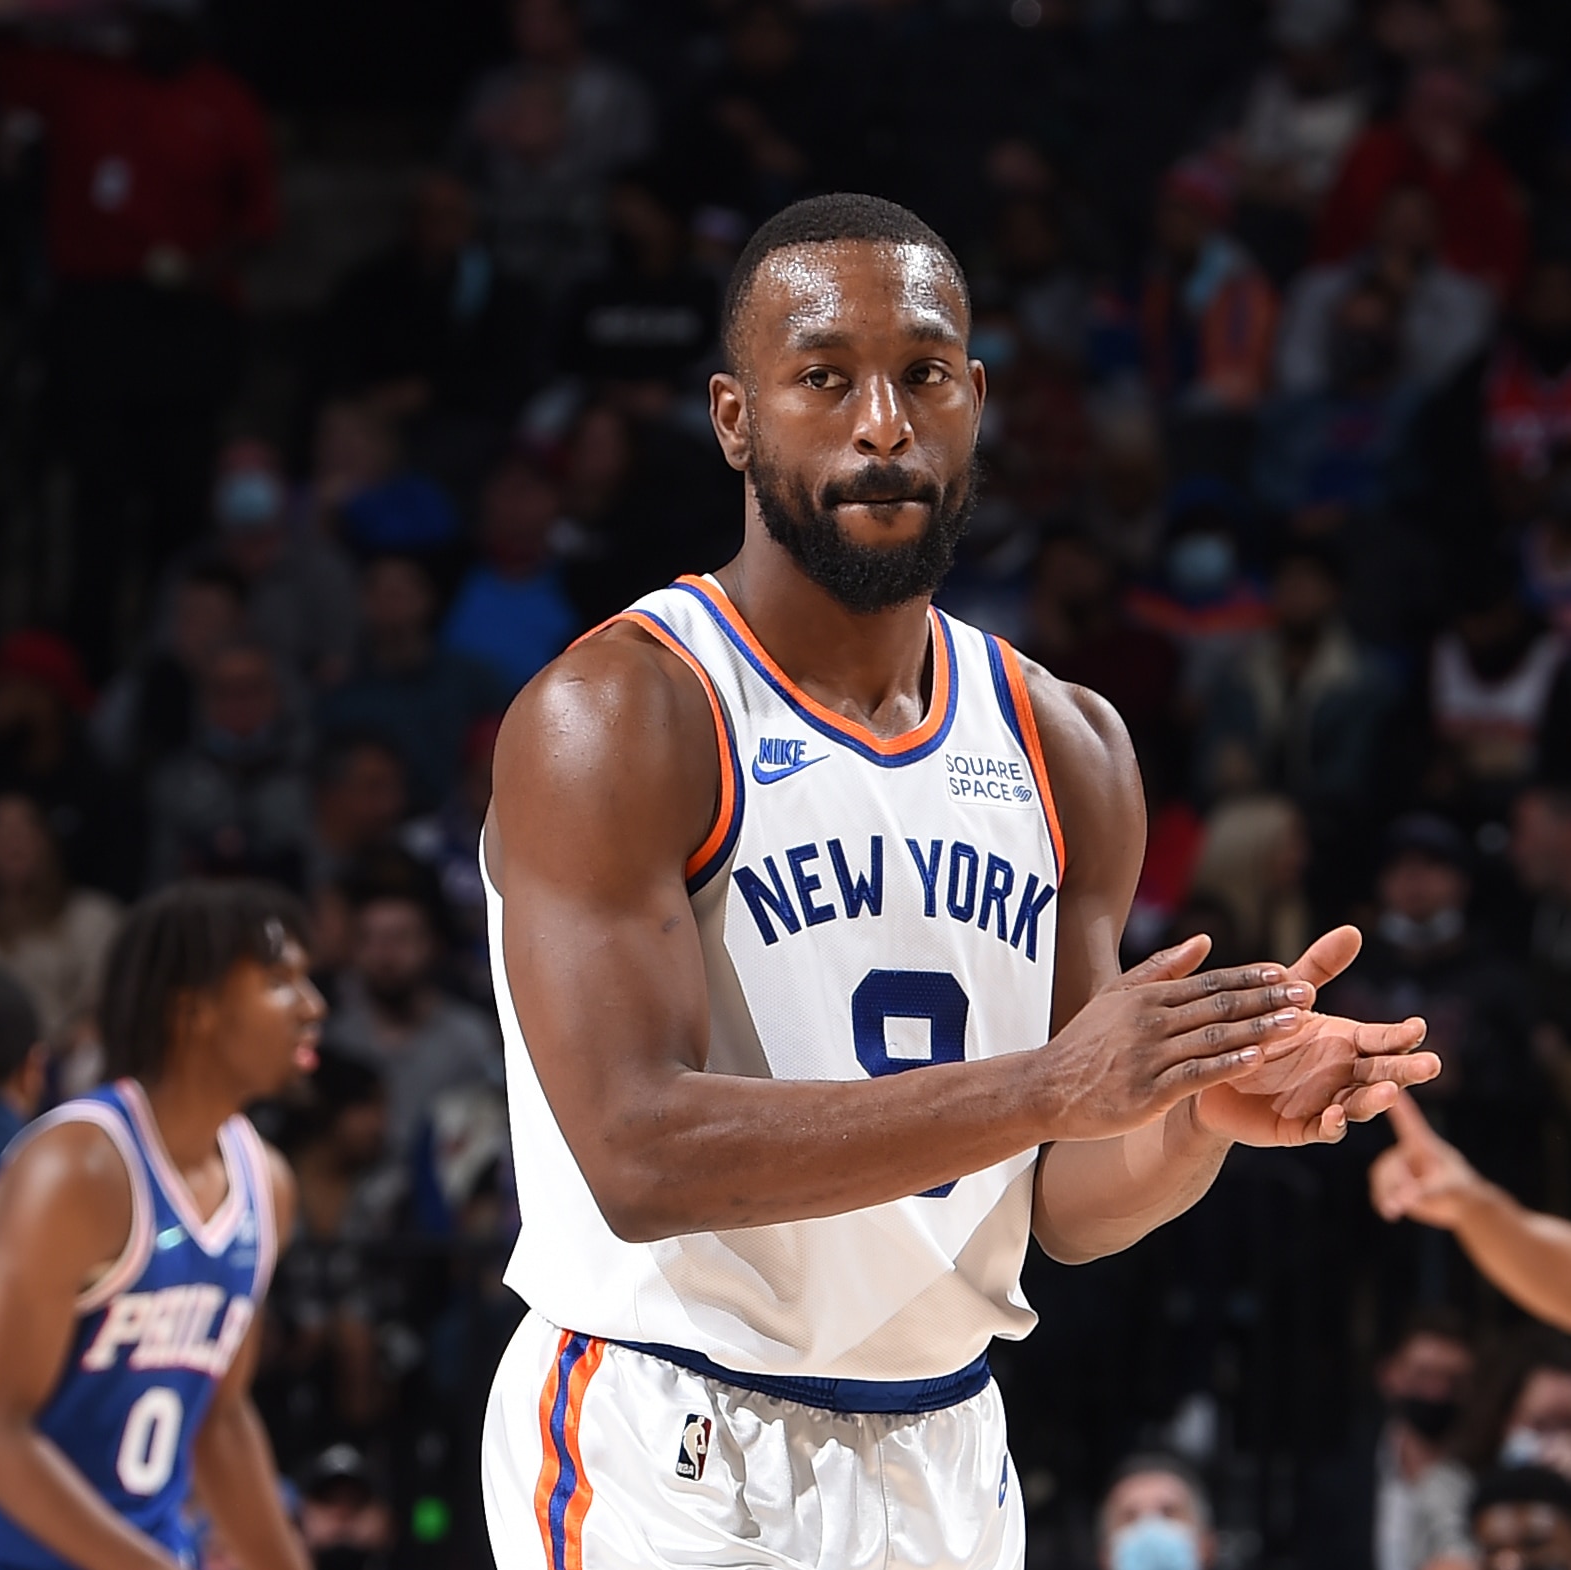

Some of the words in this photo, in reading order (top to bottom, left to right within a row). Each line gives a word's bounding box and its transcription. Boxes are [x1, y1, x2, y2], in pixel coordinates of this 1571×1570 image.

[758, 737, 807, 767] NIKE
[945, 753, 1024, 781] SQUARE
[949, 776, 1012, 802] SPACE
[732, 834, 884, 946] NEW
[904, 838, 1057, 963] YORK
[116, 1385, 184, 1497] 0
